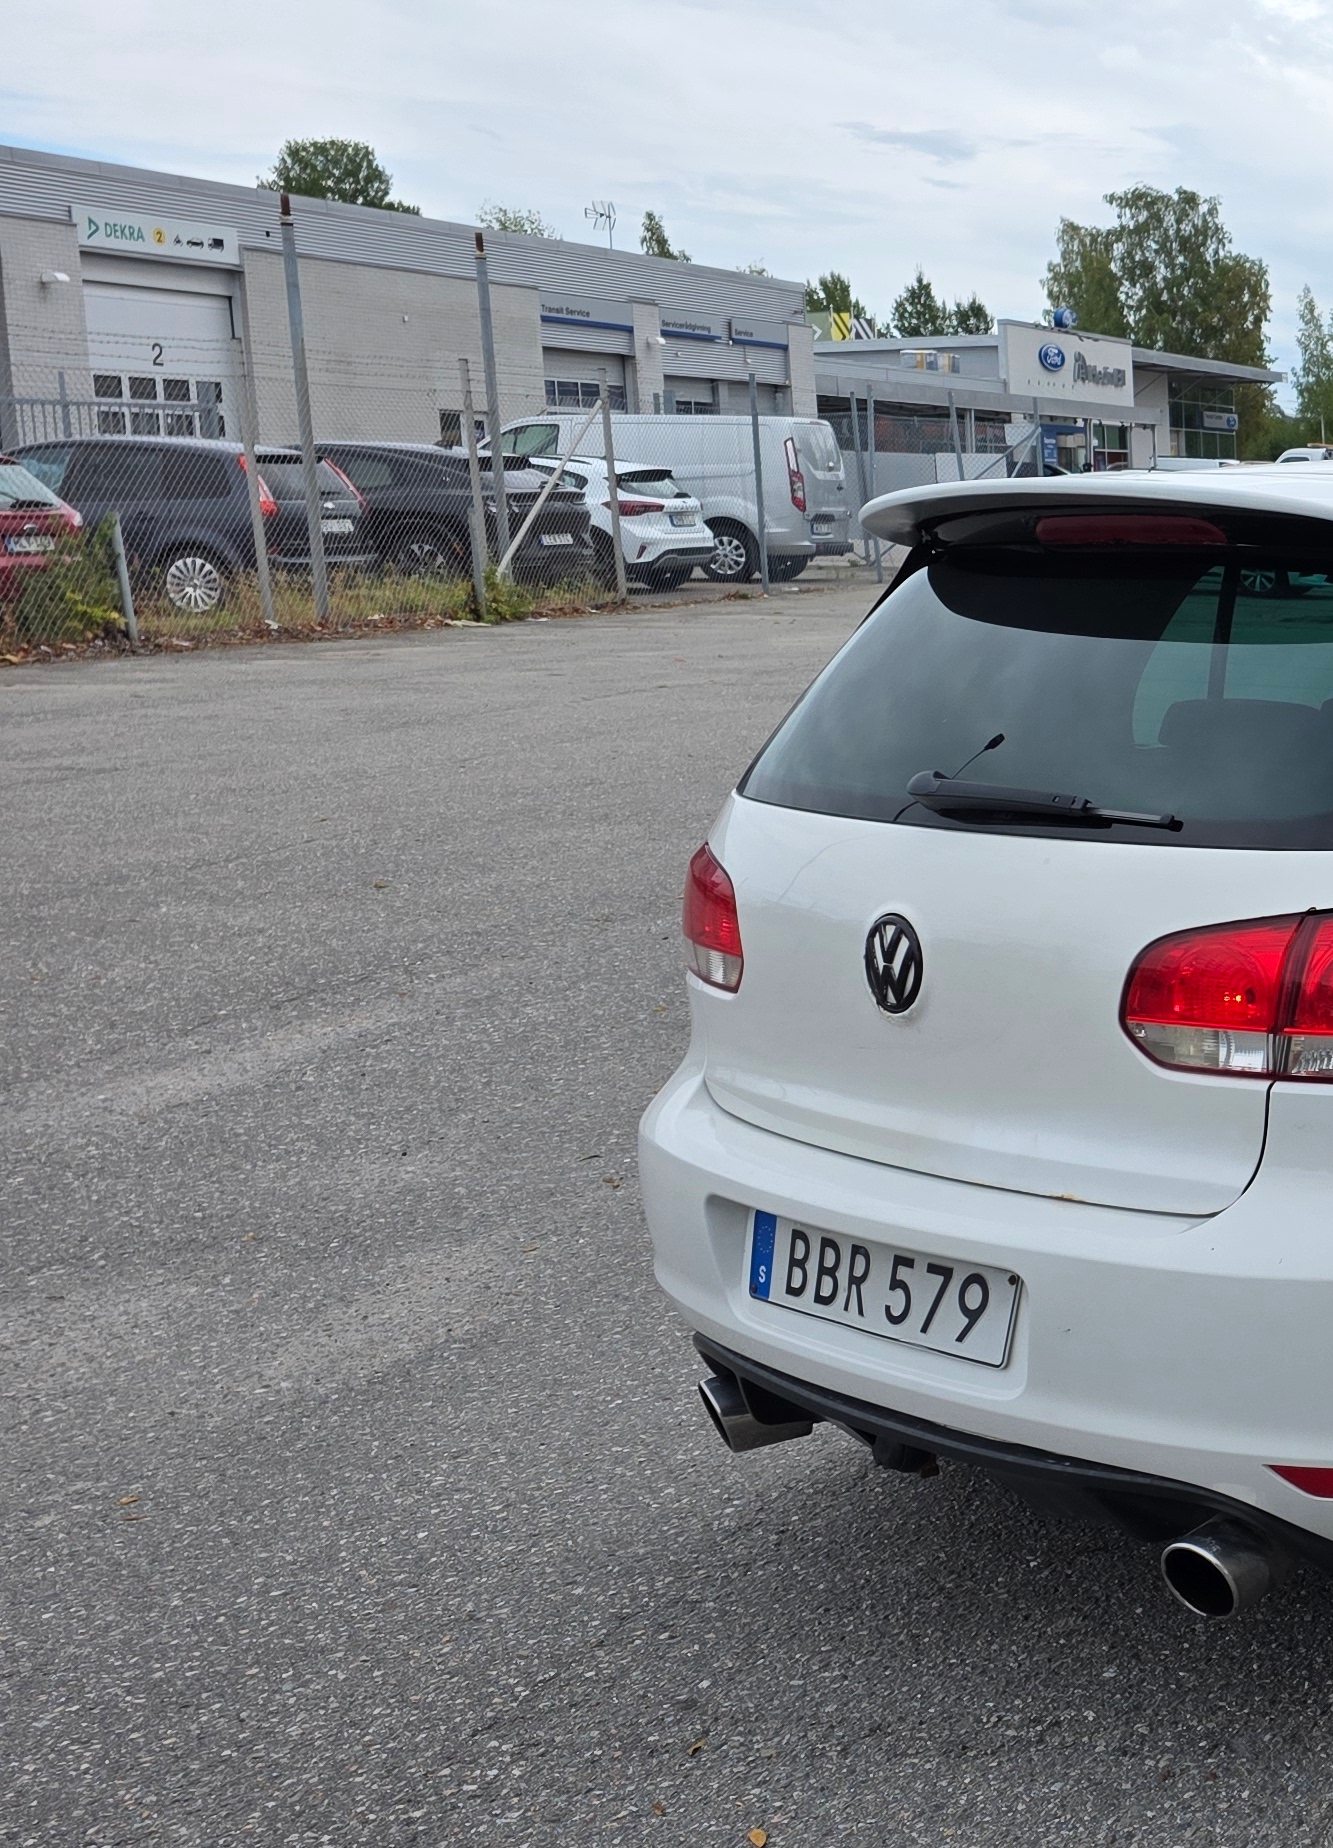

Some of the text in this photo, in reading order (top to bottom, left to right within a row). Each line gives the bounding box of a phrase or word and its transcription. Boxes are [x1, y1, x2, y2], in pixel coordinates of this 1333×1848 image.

[104, 221, 146, 243] DEKRA
[155, 230, 164, 244] 2
[541, 304, 591, 318] Transit Service
[734, 328, 754, 338] Service
[151, 342, 165, 367] 2
[758, 1228, 990, 1343] S BBR 579
